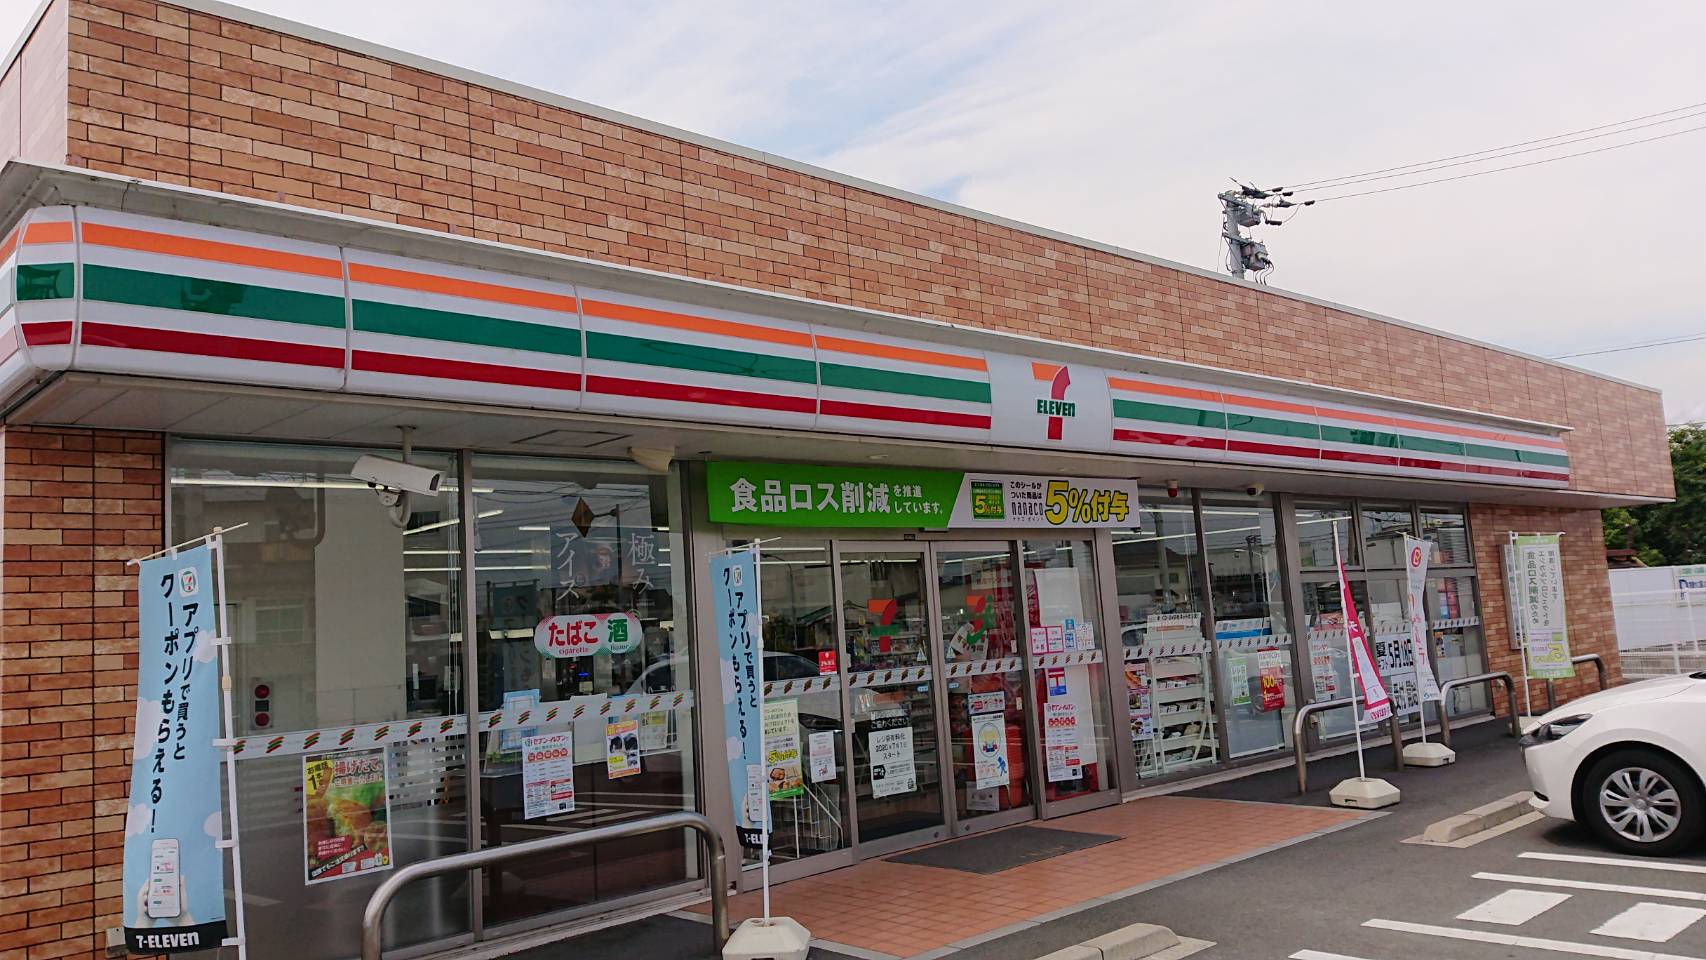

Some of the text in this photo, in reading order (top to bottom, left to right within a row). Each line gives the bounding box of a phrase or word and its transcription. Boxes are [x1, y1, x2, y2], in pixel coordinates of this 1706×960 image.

[729, 477, 891, 514] 食品ロス削減
[893, 484, 922, 498] を推進
[1010, 481, 1042, 489] このシールが
[1010, 491, 1042, 499] ついた商品は
[894, 501, 944, 514] しています。
[1011, 502, 1043, 515] nanaco
[1045, 480, 1130, 525] 5%付与
[556, 532, 580, 601] アイス
[627, 532, 656, 595] 極み
[548, 618, 629, 647] たばこ 酒
[558, 647, 590, 655] cigarette
[722, 567, 748, 760] クーポンもらえる！
[735, 591, 758, 709] アプリで買うと
[173, 602, 199, 761] アプリで買うと
[150, 573, 179, 833] クーポンもらえる！
[883, 751, 901, 760] スタート
